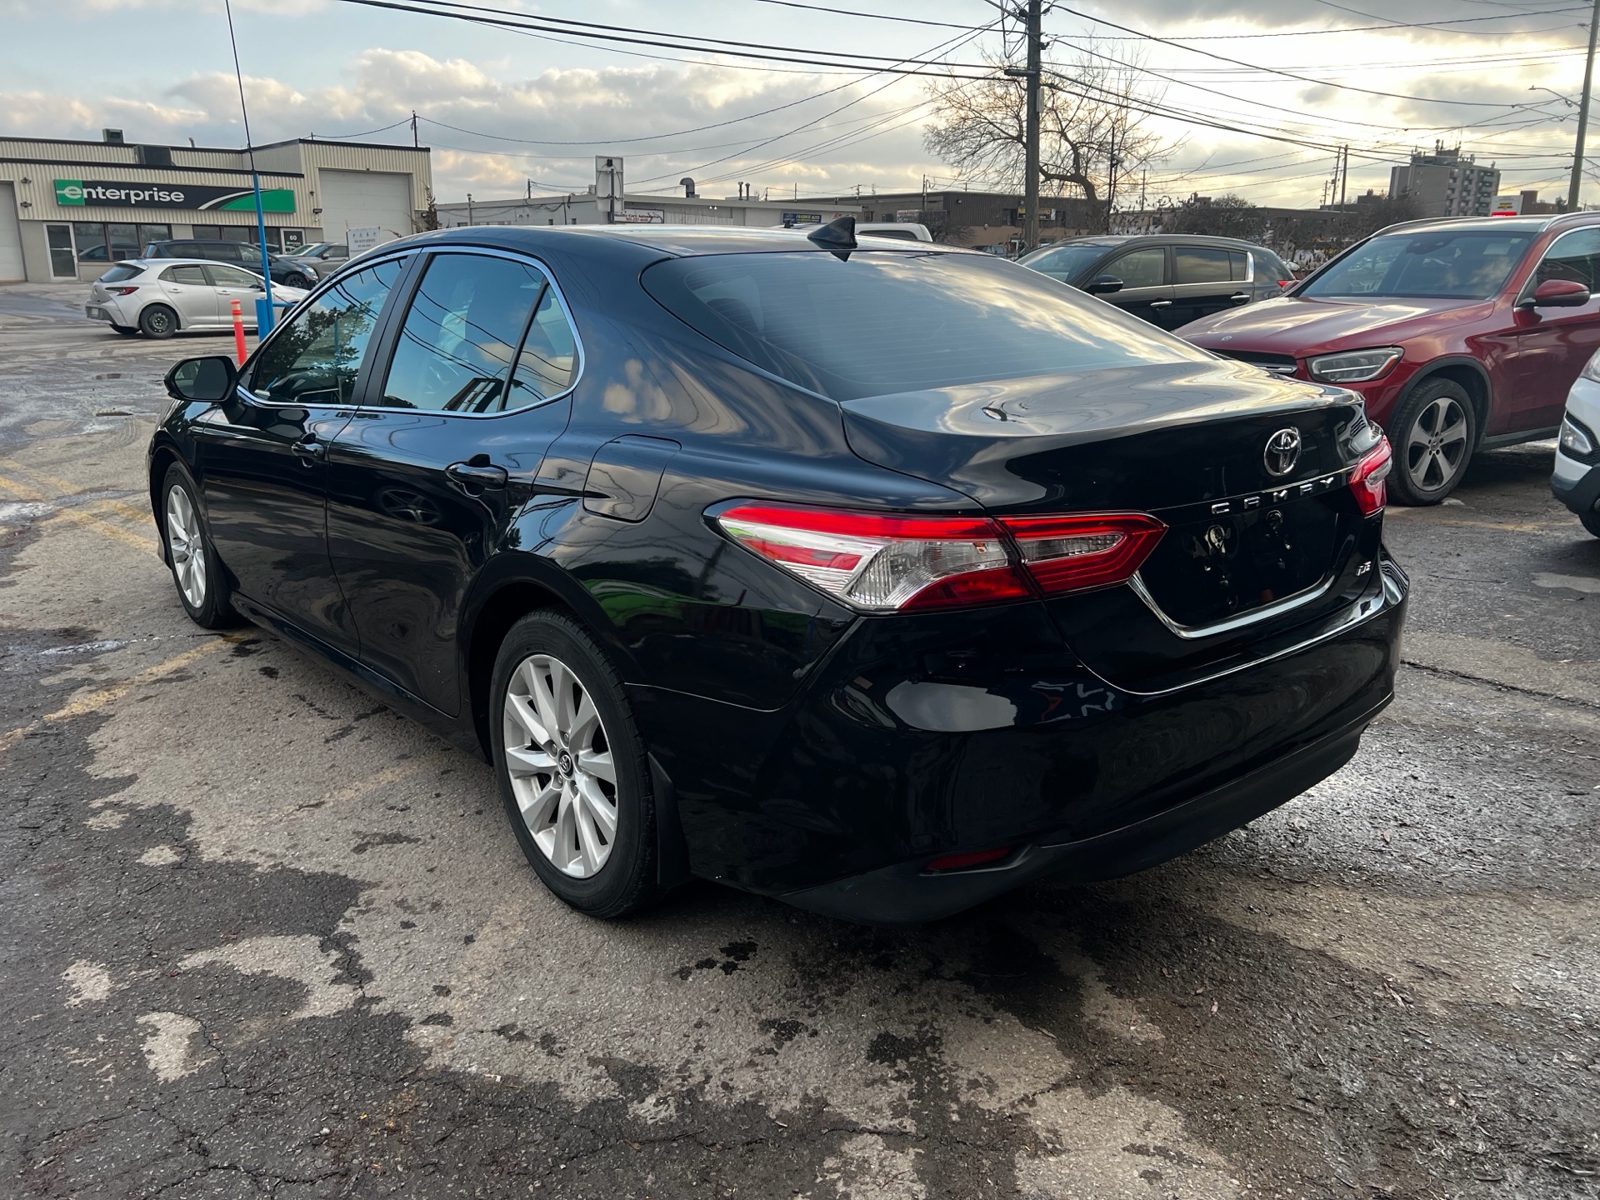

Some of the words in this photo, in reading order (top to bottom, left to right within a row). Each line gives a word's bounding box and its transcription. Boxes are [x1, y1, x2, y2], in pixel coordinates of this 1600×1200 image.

[60, 185, 185, 205] enterprise
[1211, 477, 1335, 515] CAMRY
[1356, 561, 1372, 577] LE
